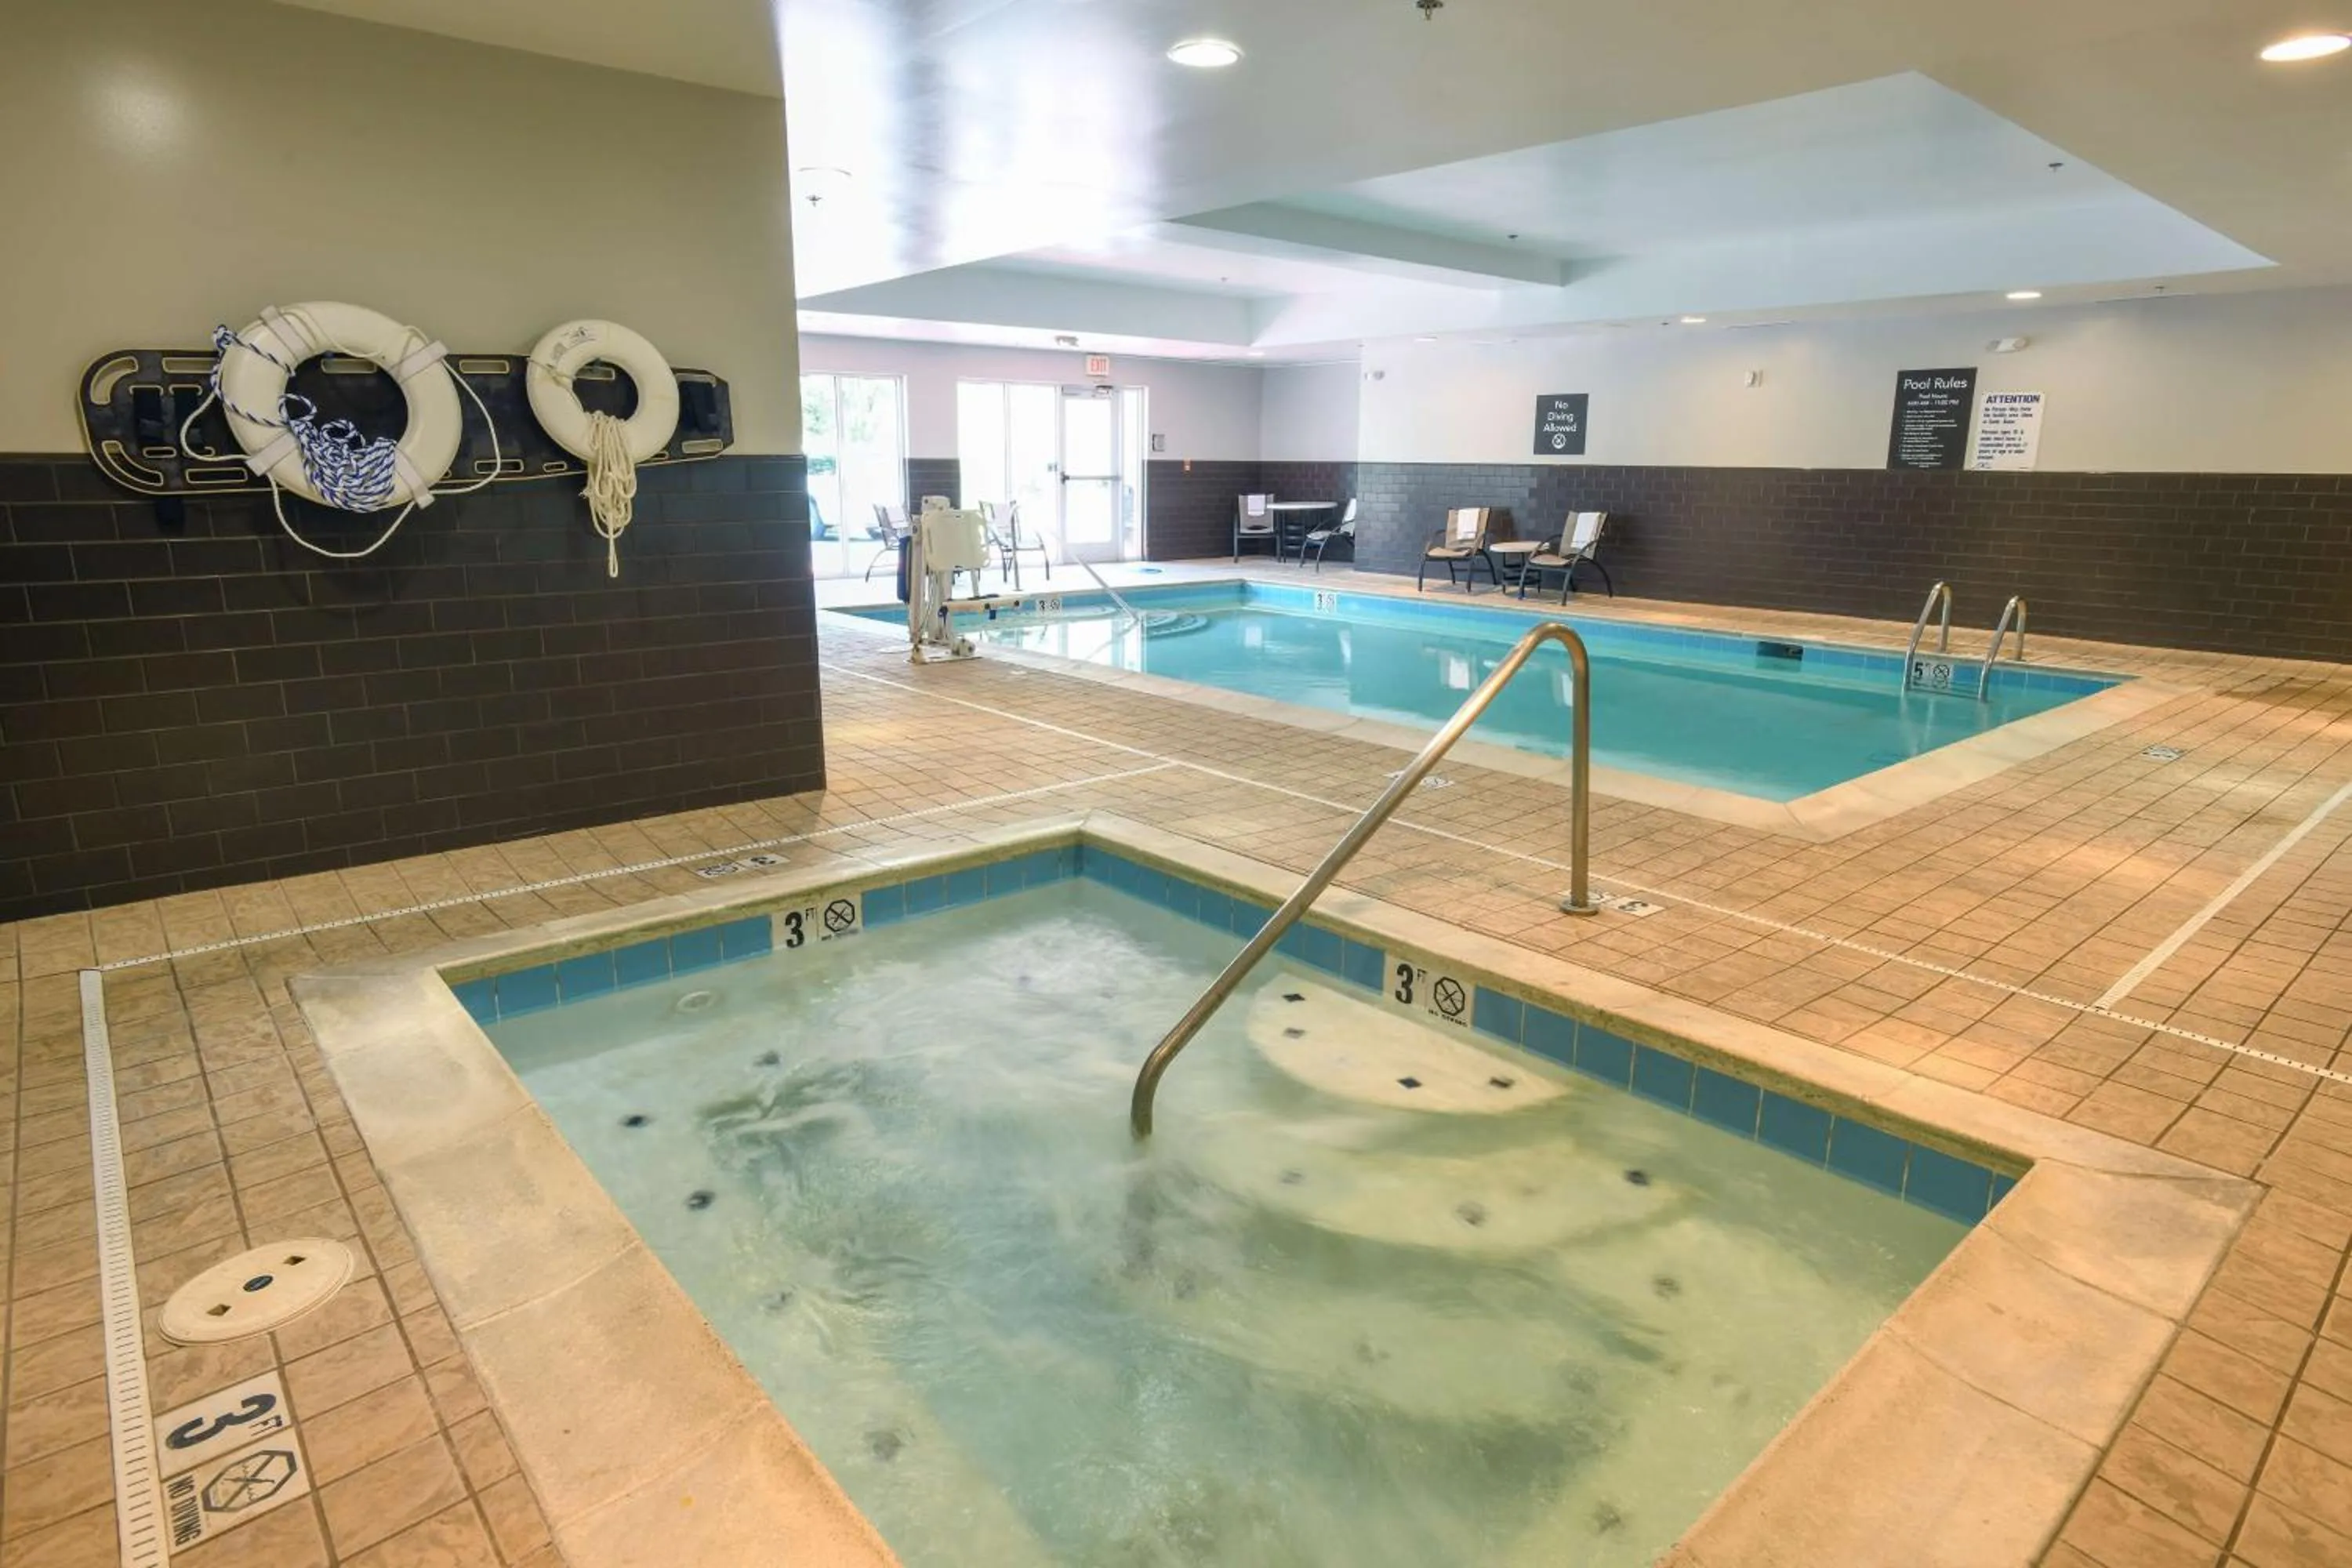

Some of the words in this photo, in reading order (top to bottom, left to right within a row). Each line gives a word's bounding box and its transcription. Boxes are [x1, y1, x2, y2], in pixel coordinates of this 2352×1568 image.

[1904, 377, 1931, 390] Pool
[1934, 376, 1968, 389] Rules
[1555, 401, 1569, 409] No
[1986, 394, 2041, 404] ATTENTION
[1547, 412, 1574, 423] Diving
[1542, 423, 1577, 432] Allowed
[1915, 662, 1923, 680] 5
[785, 911, 804, 948] 3
[805, 908, 816, 921] FT
[1396, 964, 1413, 1004] 3
[165, 1393, 277, 1450] 3
[249, 1414, 282, 1437] FT
[167, 1475, 194, 1499] NO
[170, 1495, 202, 1548] DIVING
